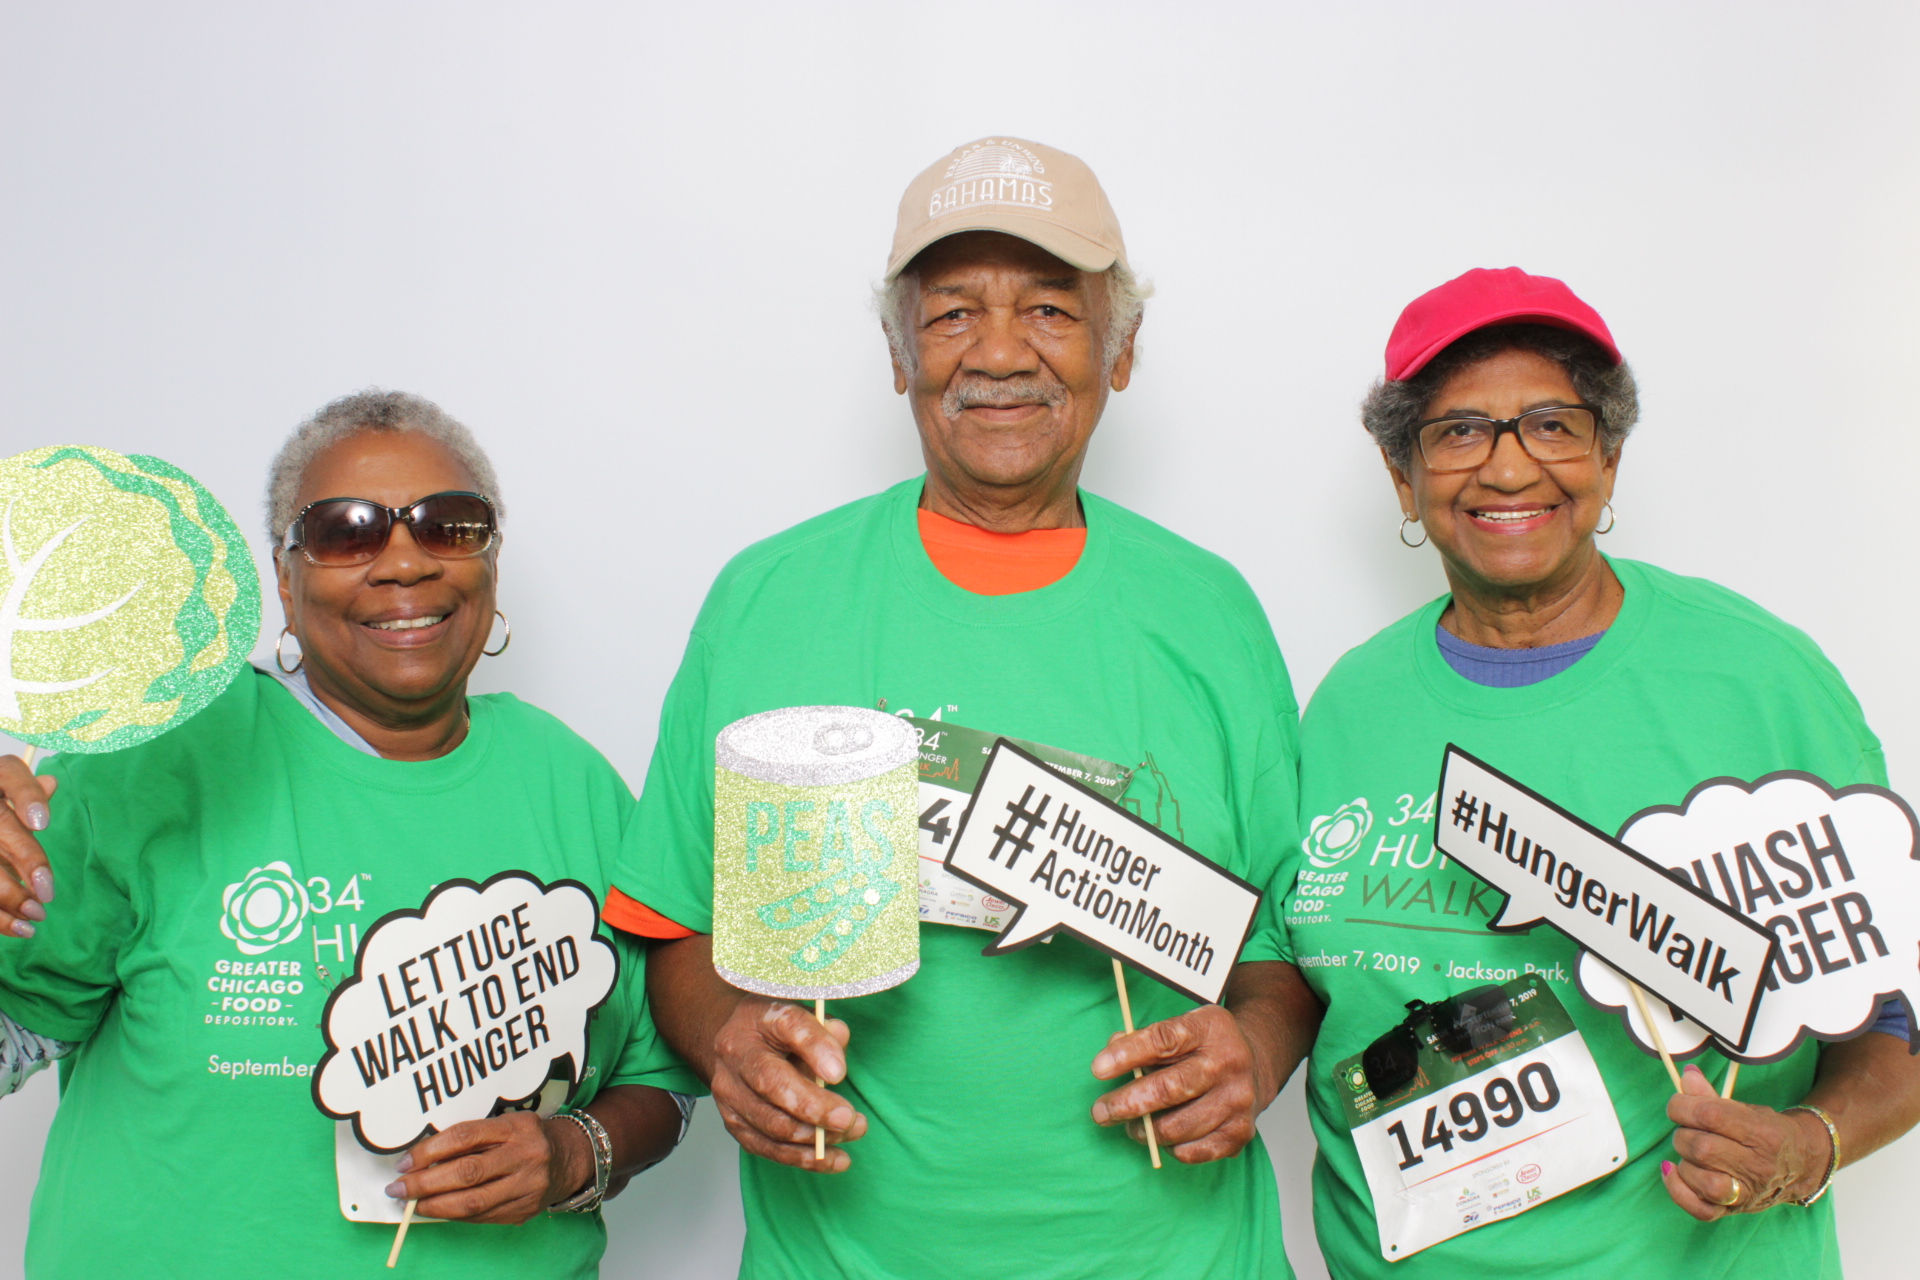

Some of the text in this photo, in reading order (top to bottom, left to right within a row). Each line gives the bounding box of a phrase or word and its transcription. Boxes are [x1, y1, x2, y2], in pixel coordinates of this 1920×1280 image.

[1001, 140, 1045, 174] UNWIND
[929, 178, 1053, 217] BAHAMAS
[918, 752, 947, 765] NGER
[919, 762, 931, 771] LK
[1084, 773, 1092, 782] 7,
[1094, 775, 1116, 787] 2019
[745, 800, 896, 874] PEAS
[1297, 870, 1349, 884] REATER
[1667, 814, 1855, 915] UASH
[1296, 884, 1344, 897] ICAGO
[1362, 873, 1492, 918] WALK
[1451, 789, 1741, 1005] #HungerWalk
[1030, 849, 1216, 977] ActionMonth
[1293, 899, 1325, 912] OOD
[1764, 892, 1890, 992] GER
[215, 960, 302, 976] GREATER
[377, 902, 536, 1019] LETTUCE
[1352, 950, 1367, 970] 7,
[1372, 952, 1421, 975] 2019
[1445, 960, 1570, 984] Jackson Park,
[207, 976, 304, 995] CHICAGO
[1517, 988, 1538, 1003] 2019
[351, 934, 580, 1089] WALK TO END
[208, 1055, 317, 1080] September
[412, 1004, 550, 1115] HUNGER
[1467, 1055, 1485, 1067] STEPS
[1484, 1048, 1499, 1059] OFF
[1386, 1061, 1561, 1171] 14990
